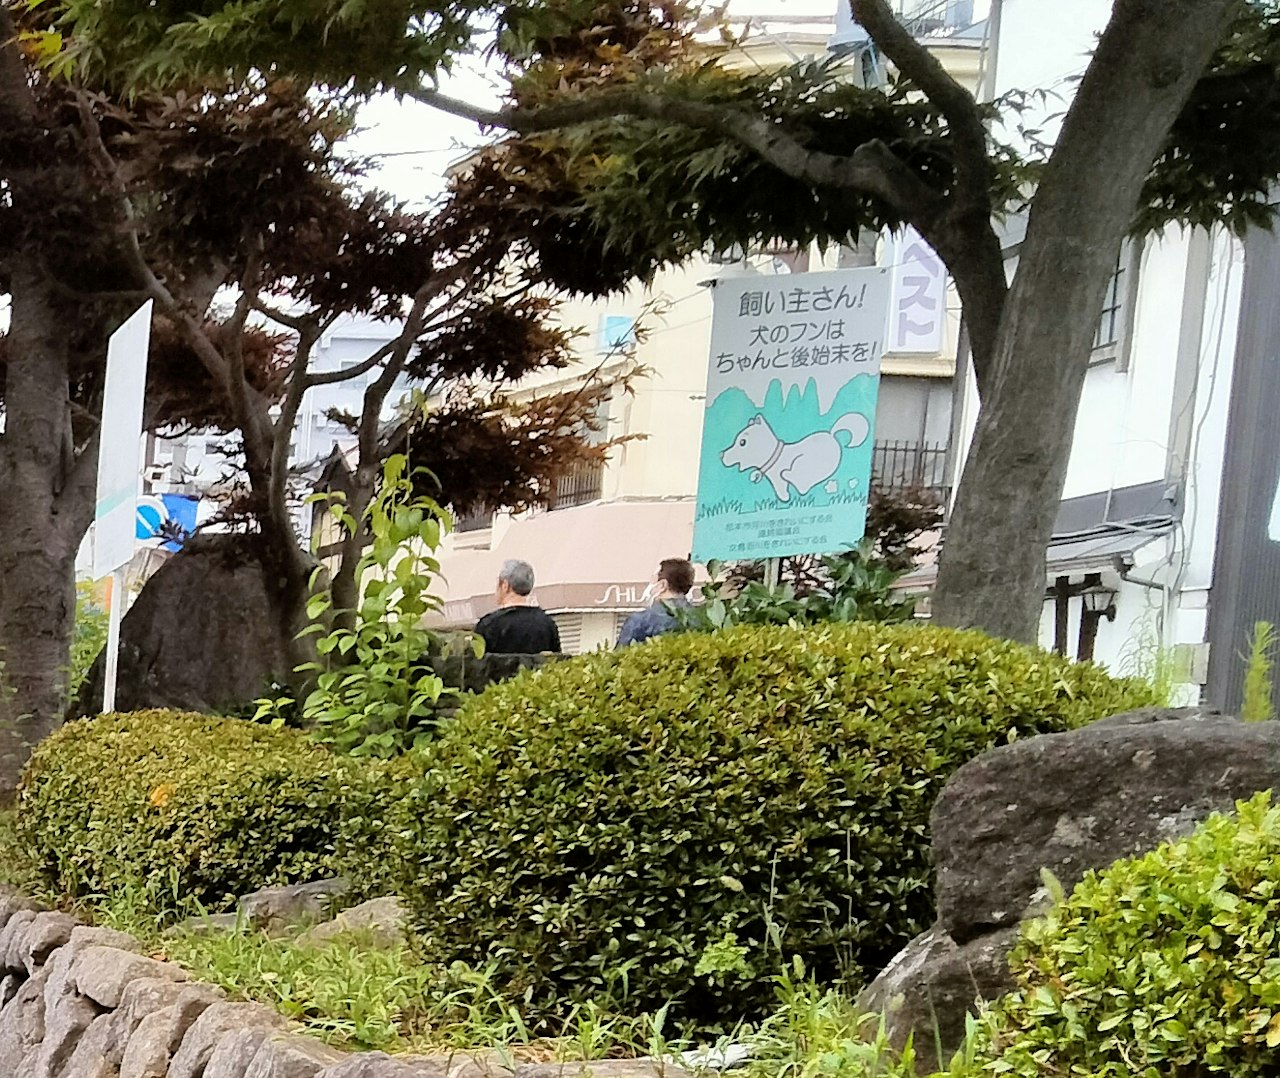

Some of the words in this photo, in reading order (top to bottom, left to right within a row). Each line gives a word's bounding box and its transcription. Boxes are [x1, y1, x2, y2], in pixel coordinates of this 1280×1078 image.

[738, 283, 868, 318] 飼い主さん!
[748, 318, 846, 347] 犬のフンは
[715, 341, 879, 374] ちゃんと後始末を!
